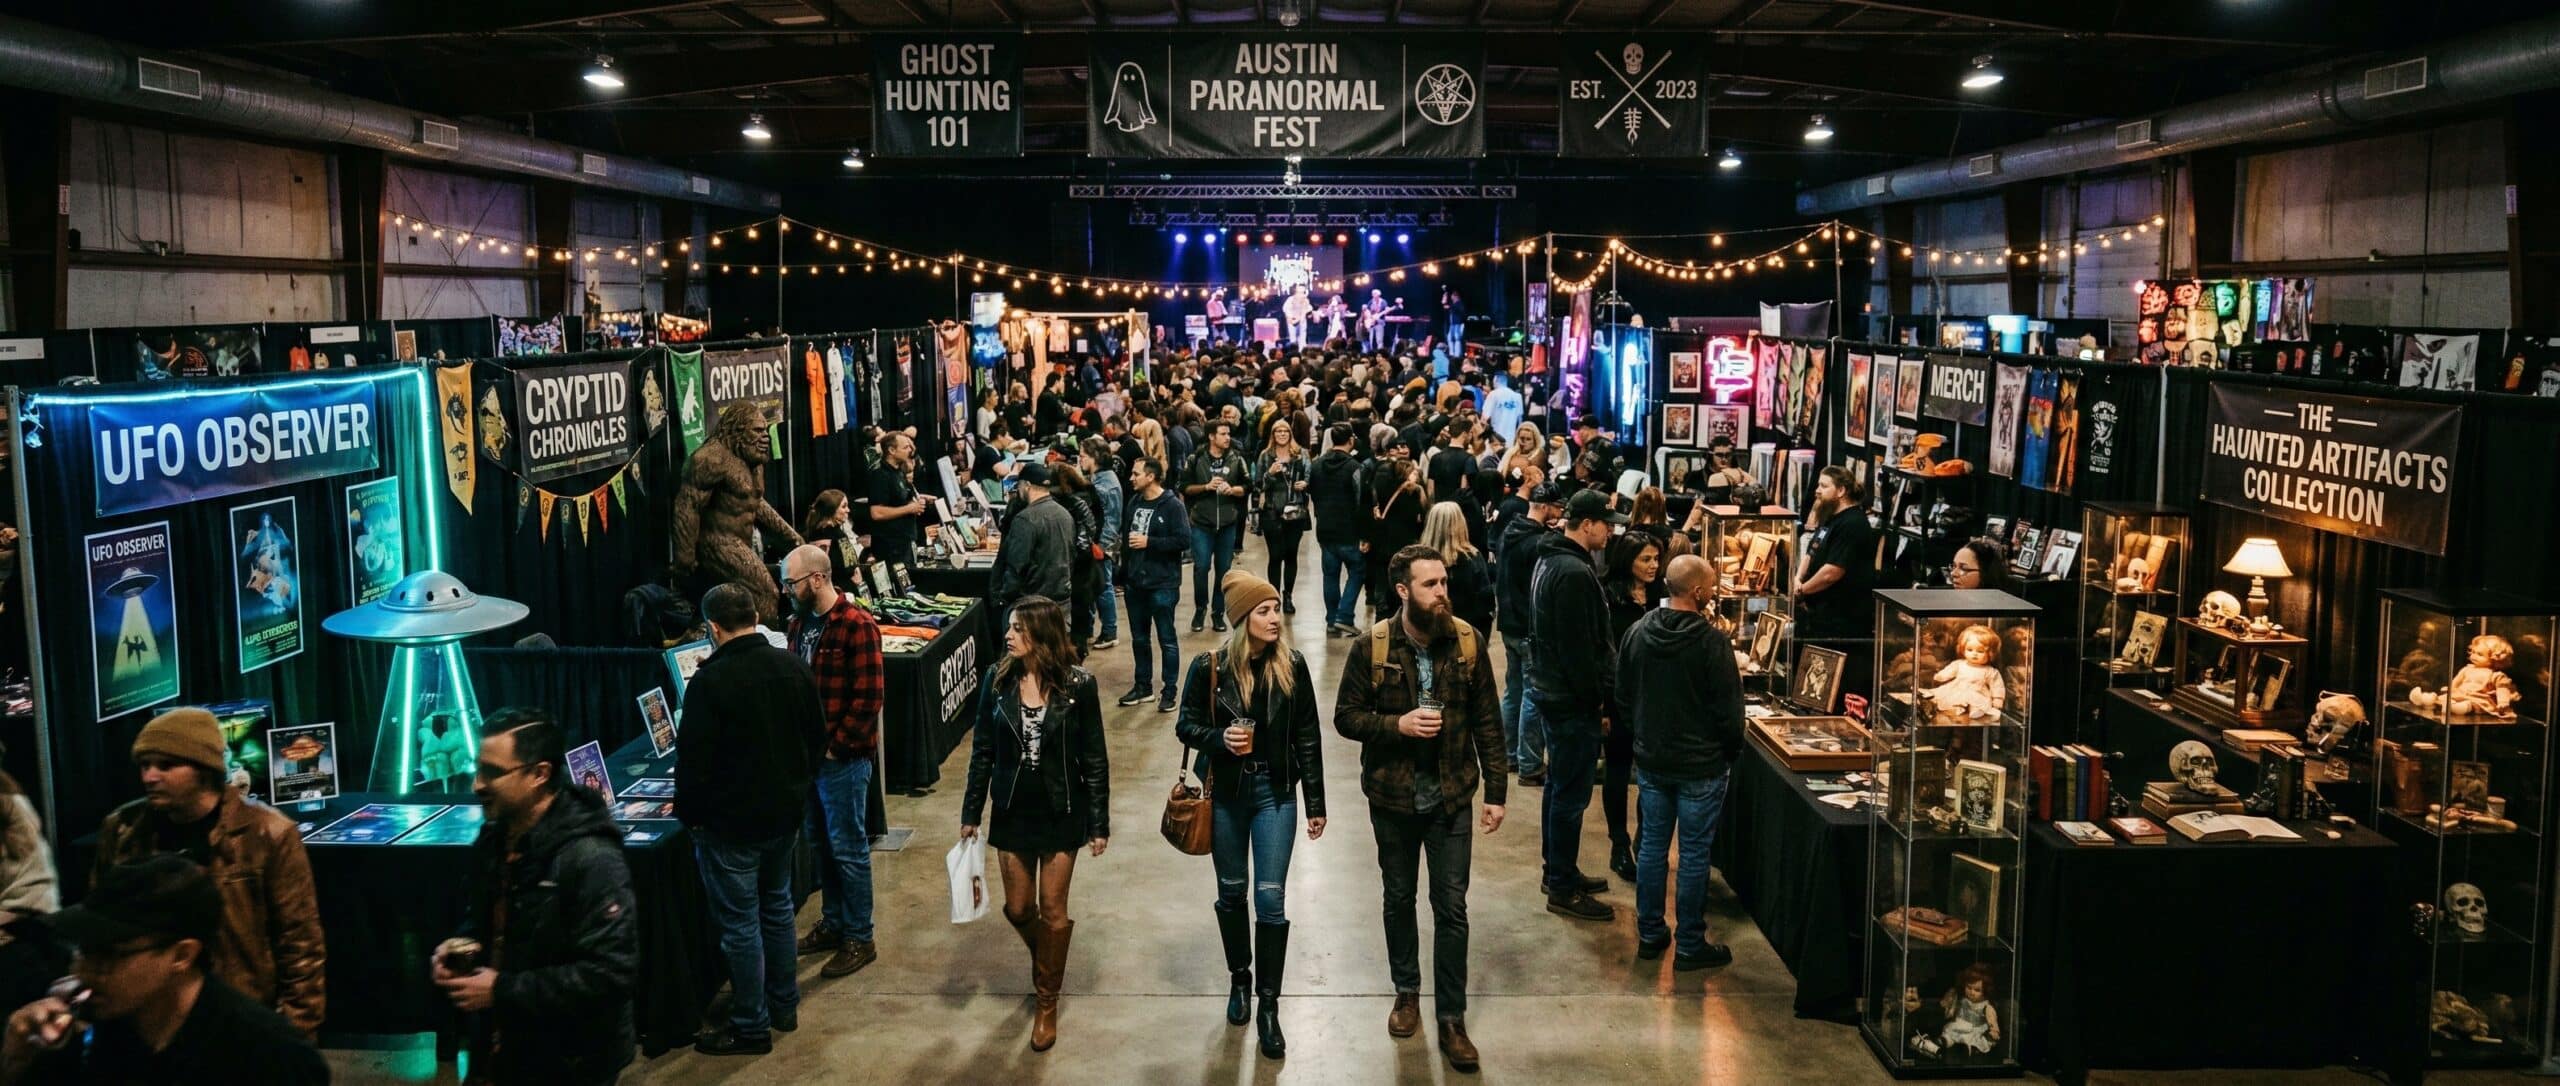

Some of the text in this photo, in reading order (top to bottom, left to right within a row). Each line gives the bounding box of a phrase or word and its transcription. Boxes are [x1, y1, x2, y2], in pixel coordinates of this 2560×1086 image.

[902, 43, 994, 76] GHOST
[1235, 43, 1338, 75] AUSTIN
[886, 80, 1010, 112] HUNTING
[1190, 80, 1385, 111] PARANORMAL
[1571, 80, 1606, 100] EST.
[1655, 80, 1697, 100] 2023
[927, 117, 969, 147] 101
[1254, 117, 1321, 147] FEST
[710, 360, 784, 402] CRYPTIDS
[1930, 364, 1986, 404] MERCH
[526, 371, 626, 424] CRYPTID
[2298, 402, 2334, 433] THE
[101, 403, 371, 485] UFO OBSERVER
[529, 416, 627, 459] CHRONICLES
[2212, 423, 2448, 493] HAUNTED ARTIFACTS
[2243, 467, 2385, 527] COLLECTION
[92, 543, 113, 562] UFO
[115, 533, 166, 557] OBSERVER
[940, 635, 976, 697] CRYPTID
